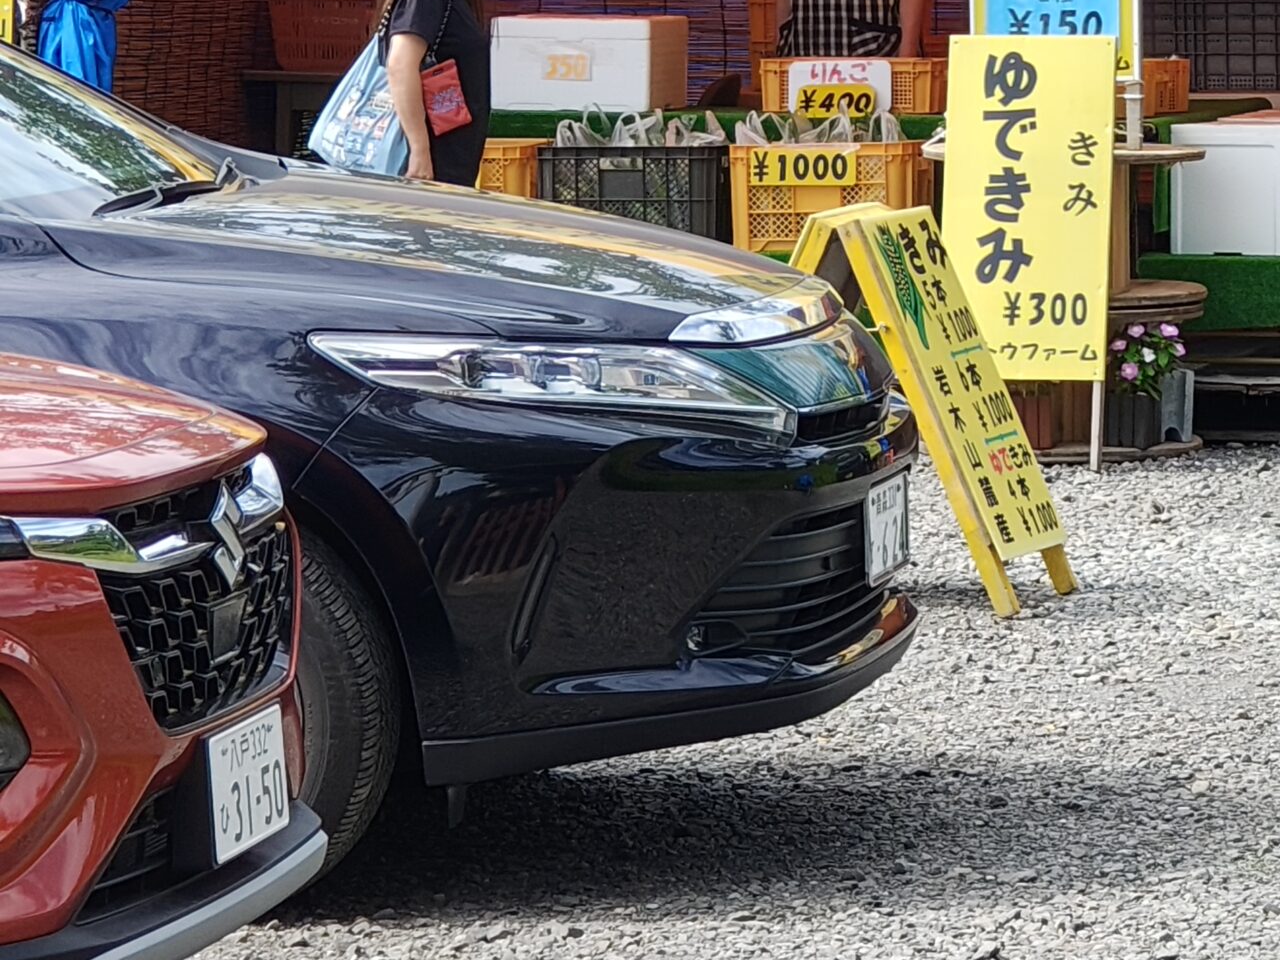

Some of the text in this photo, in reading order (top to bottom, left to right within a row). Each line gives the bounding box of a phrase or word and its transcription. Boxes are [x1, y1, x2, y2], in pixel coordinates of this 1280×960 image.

[810, 62, 873, 84] りんご
[799, 88, 872, 114] ¥400
[752, 150, 848, 183] ¥1000
[975, 50, 1038, 285] ゆできみ
[1062, 130, 1100, 217] きみ
[898, 218, 948, 275] きみ
[1002, 291, 1088, 327] ¥300
[231, 758, 284, 843] 31-50
